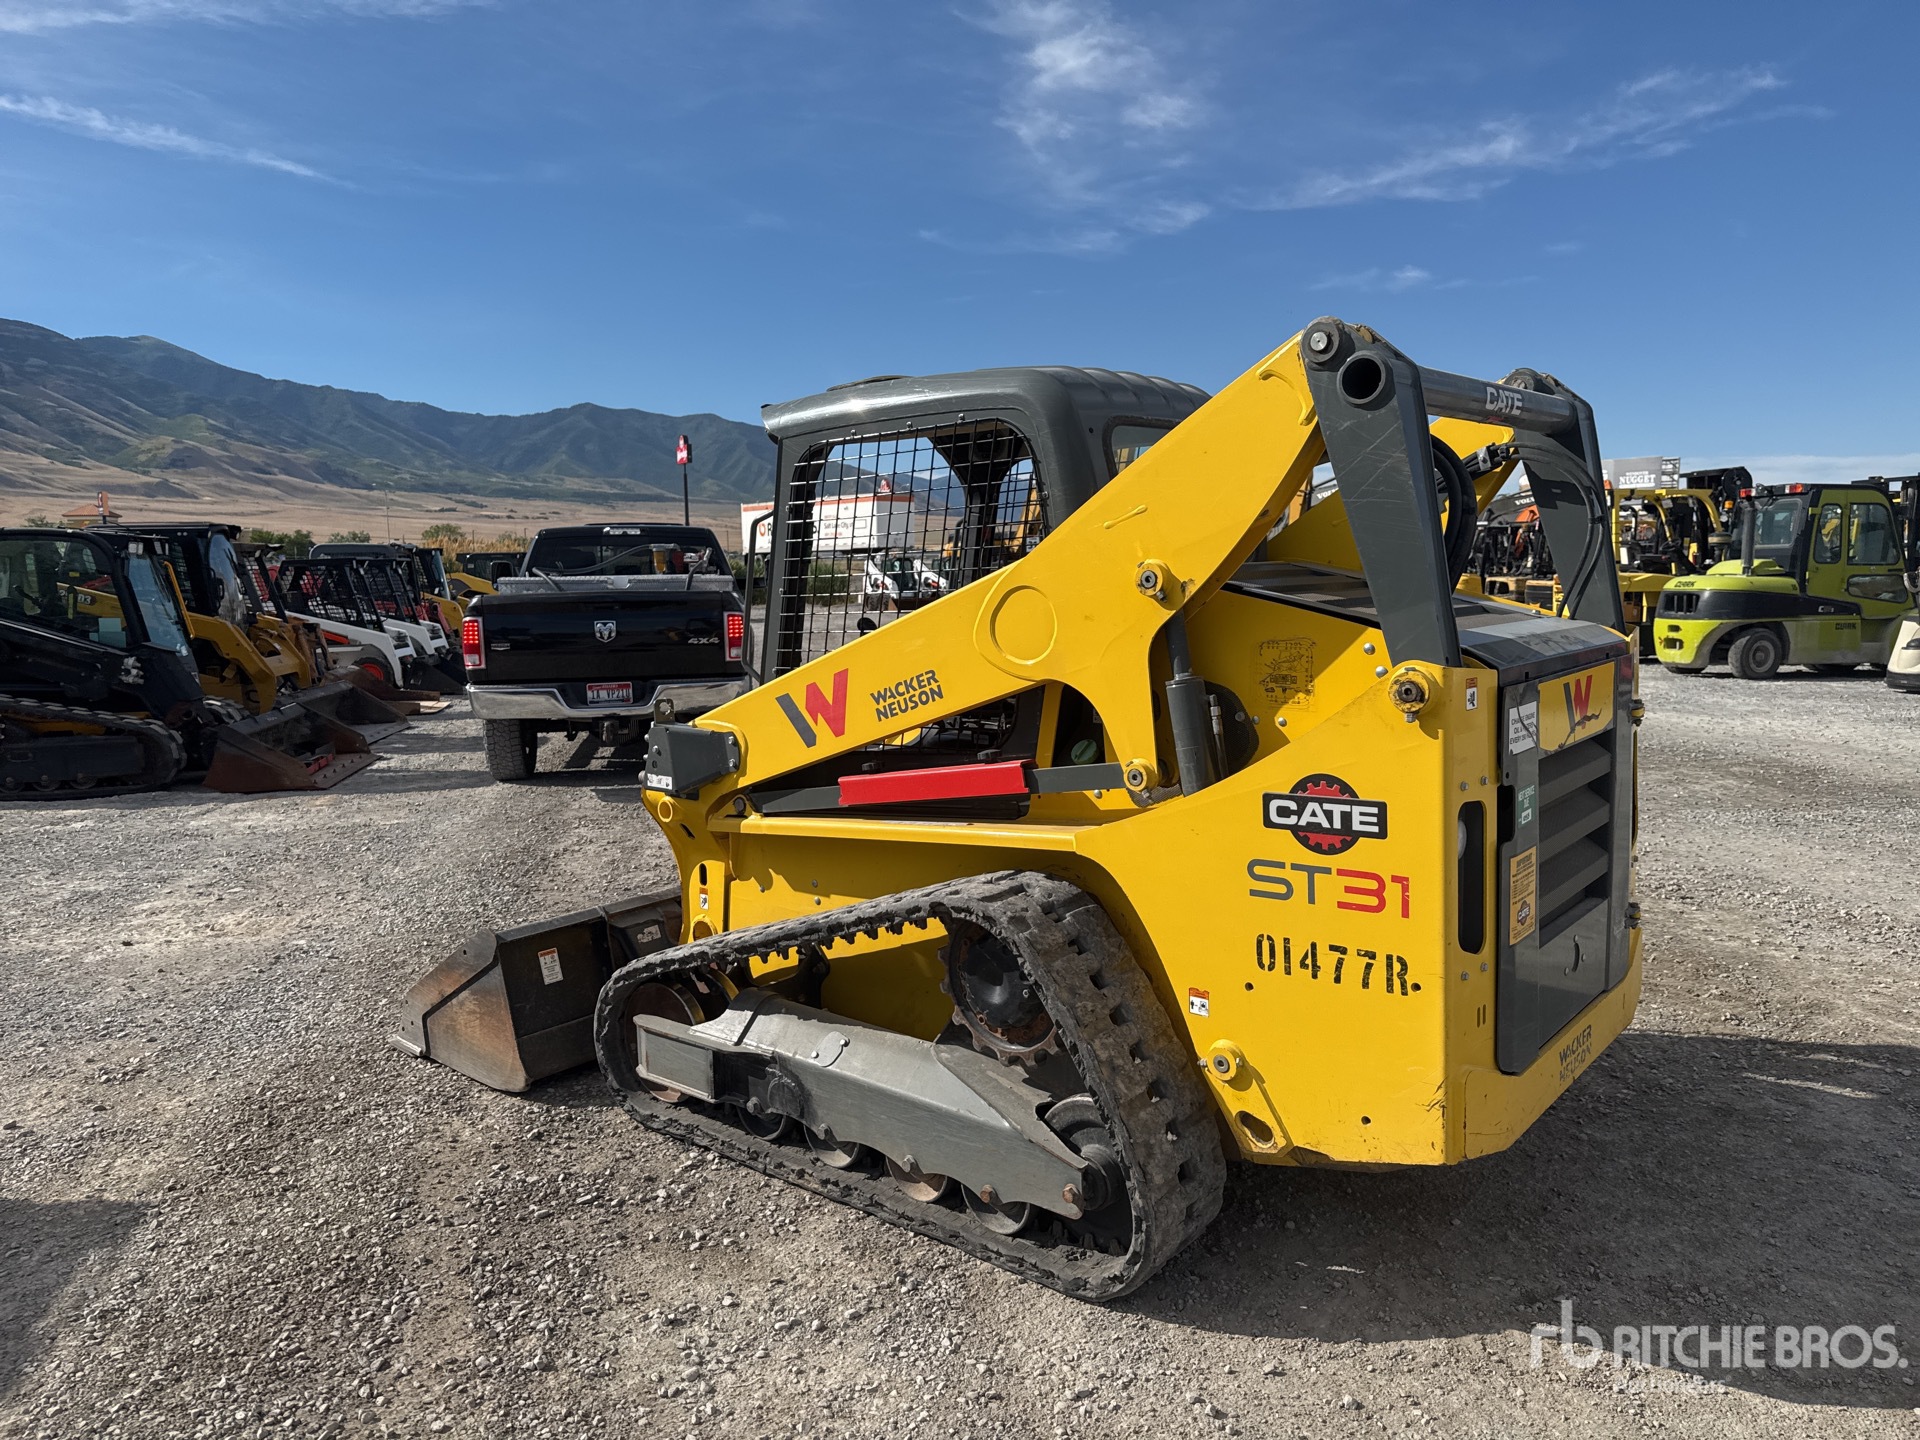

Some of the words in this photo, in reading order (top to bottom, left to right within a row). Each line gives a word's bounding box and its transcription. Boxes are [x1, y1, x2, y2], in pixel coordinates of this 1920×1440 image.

[1485, 387, 1523, 416] CATE
[1619, 474, 1656, 484] NUGGET
[870, 669, 940, 706] WACKER
[875, 684, 944, 722] NEUSON
[1269, 799, 1380, 833] CATE
[1247, 858, 1410, 919] ST31
[1559, 1024, 1592, 1067] WACKER
